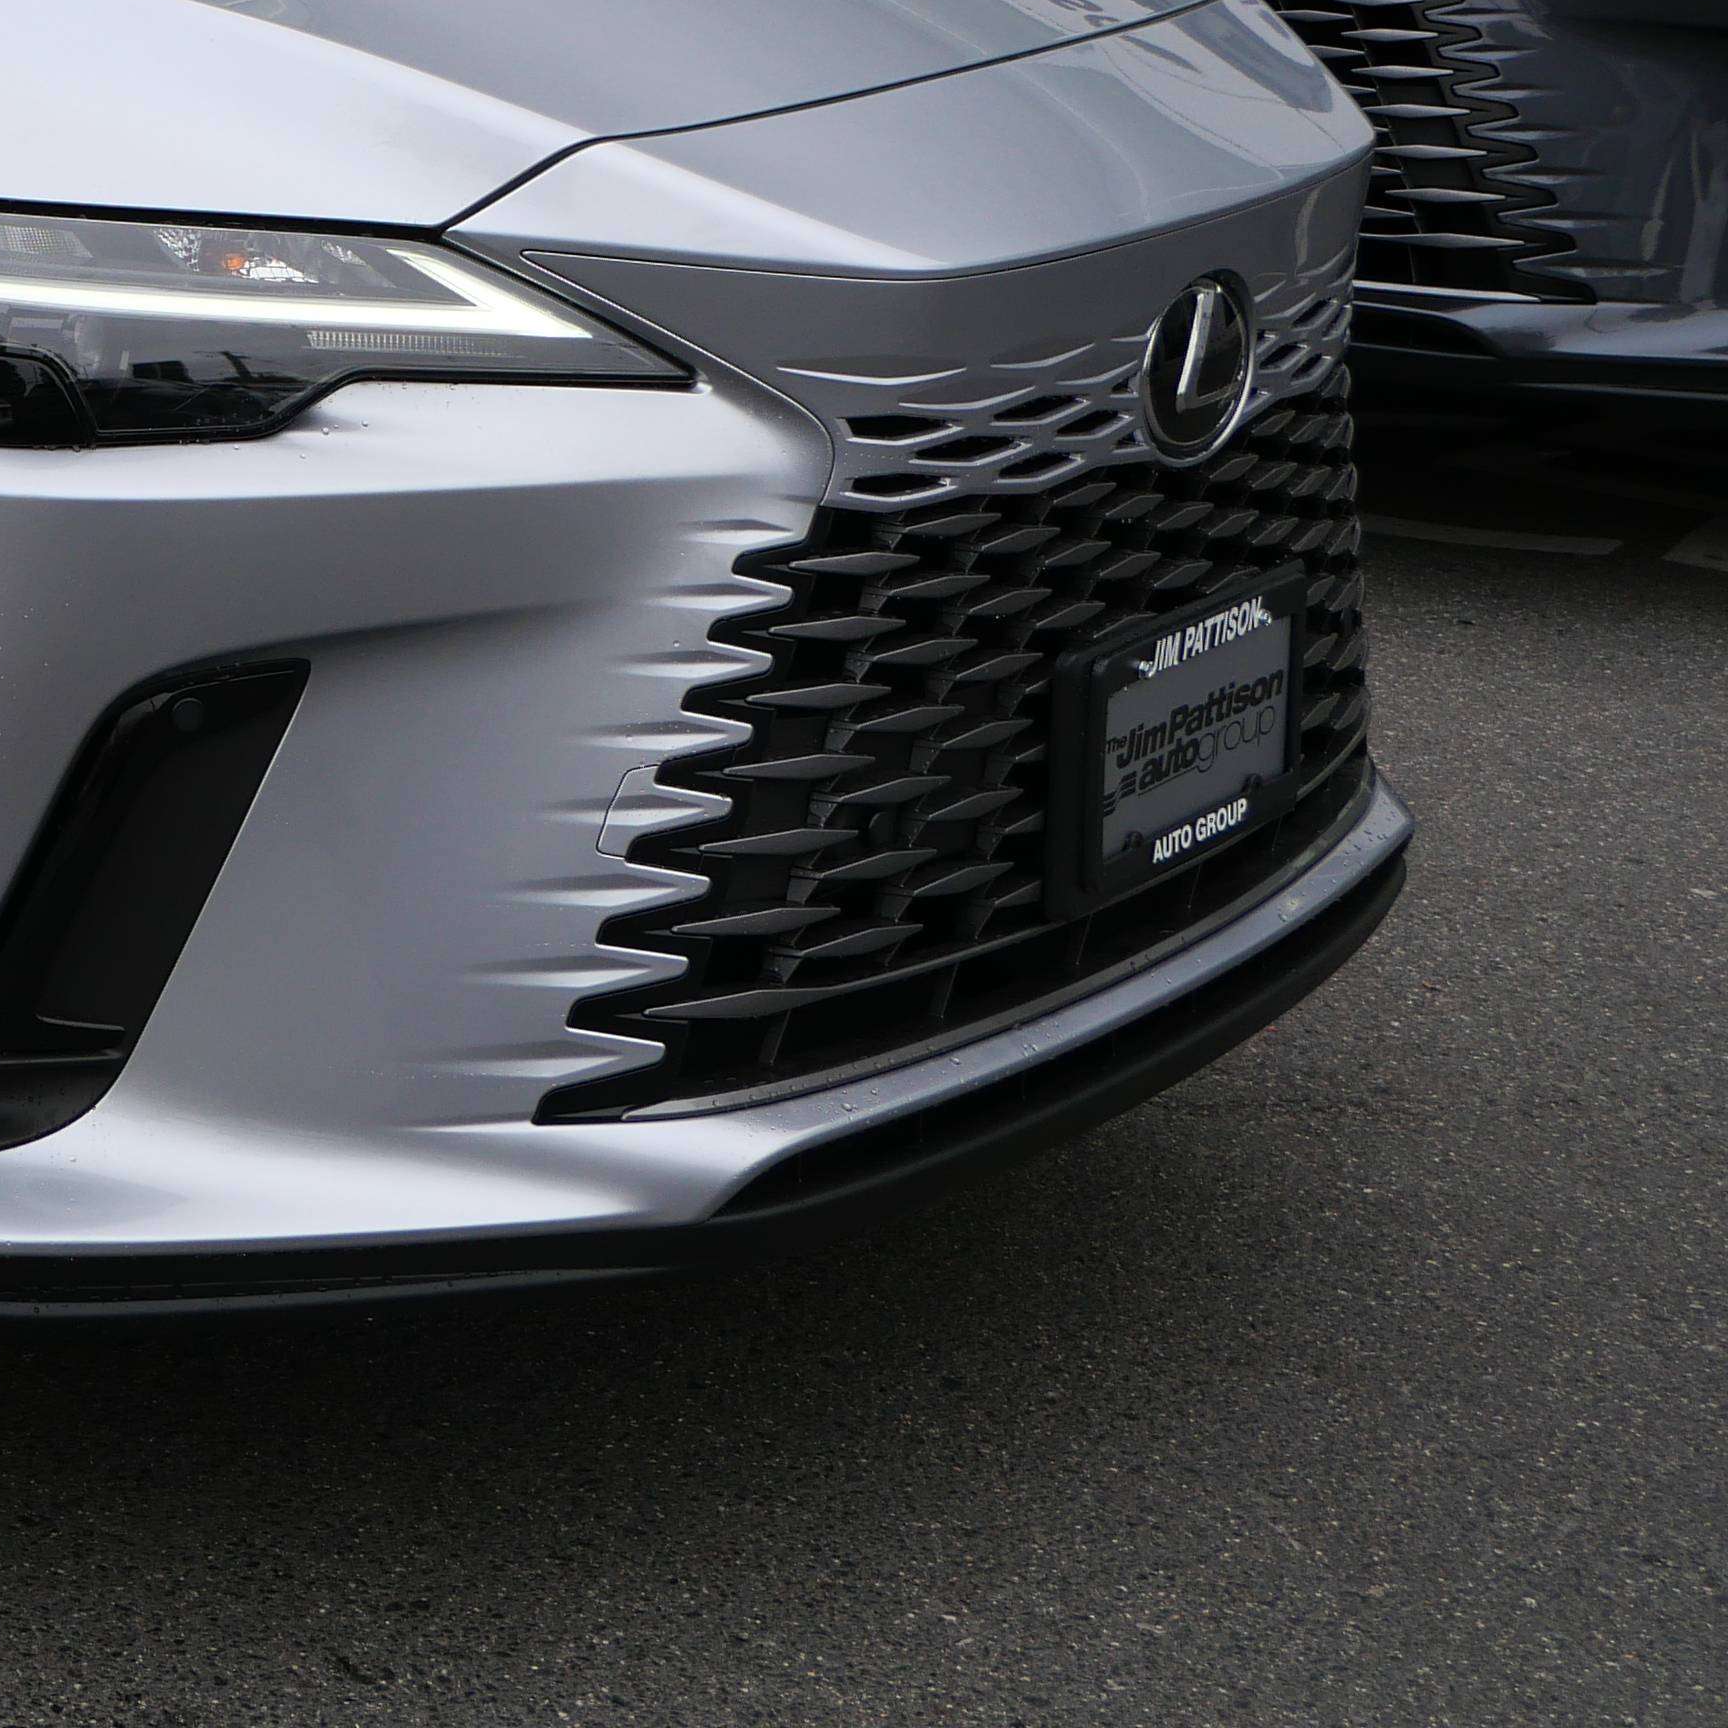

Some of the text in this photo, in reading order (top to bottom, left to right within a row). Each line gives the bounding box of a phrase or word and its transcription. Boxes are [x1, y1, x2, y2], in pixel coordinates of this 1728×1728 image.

[1147, 595, 1263, 678] JIM PATTISON
[1152, 797, 1249, 864] AUTO GROUP
